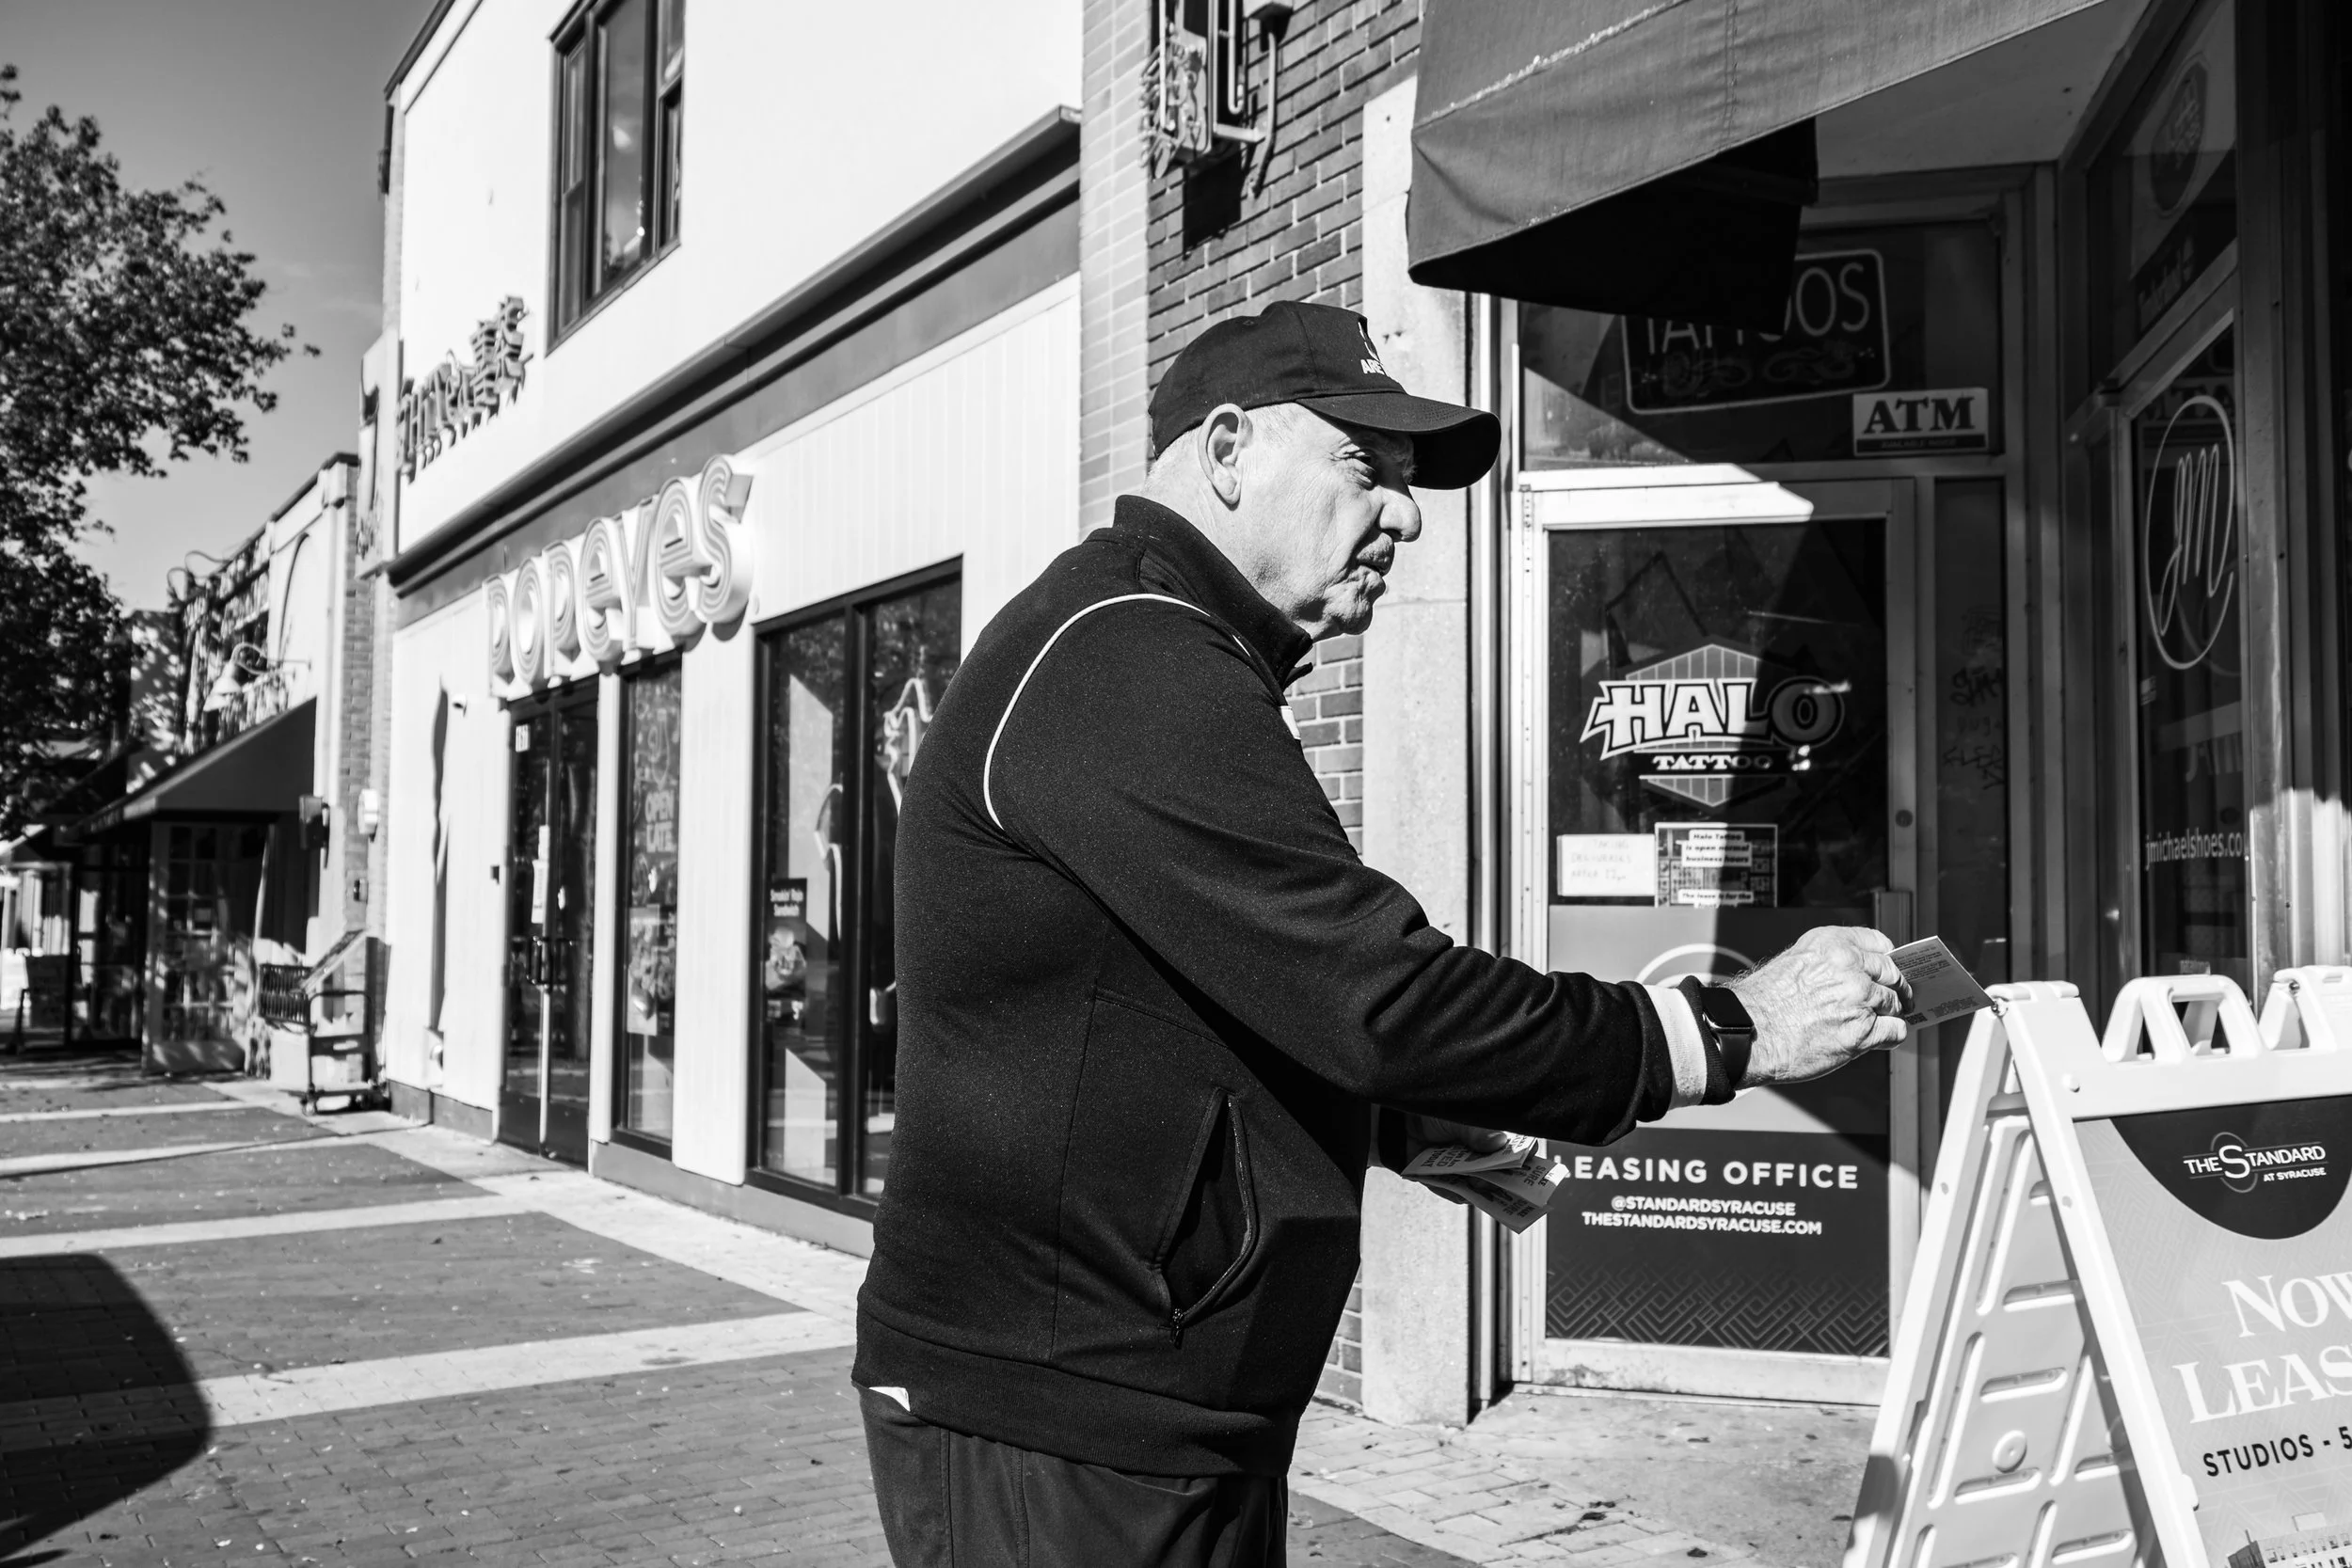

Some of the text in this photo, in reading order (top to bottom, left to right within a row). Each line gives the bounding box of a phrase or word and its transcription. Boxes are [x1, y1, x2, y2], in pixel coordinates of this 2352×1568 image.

[1863, 397, 1976, 434] ATM
[1581, 675, 1845, 760] HALO
[1652, 754, 1773, 770] TATTOO
[2183, 1145, 2327, 1179] THE STANDARD
[2263, 1166, 2328, 1182] AT SYRACUSE
[1523, 1165, 1546, 1187] SURE
[1723, 1161, 1858, 1189] OFFICE
[1611, 1195, 1796, 1216] @STANDARDSYRACUSE
[1581, 1212, 1822, 1235] THESTANDARDSYRACUSE.COM
[2202, 1433, 2314, 1477] STUDIOS
